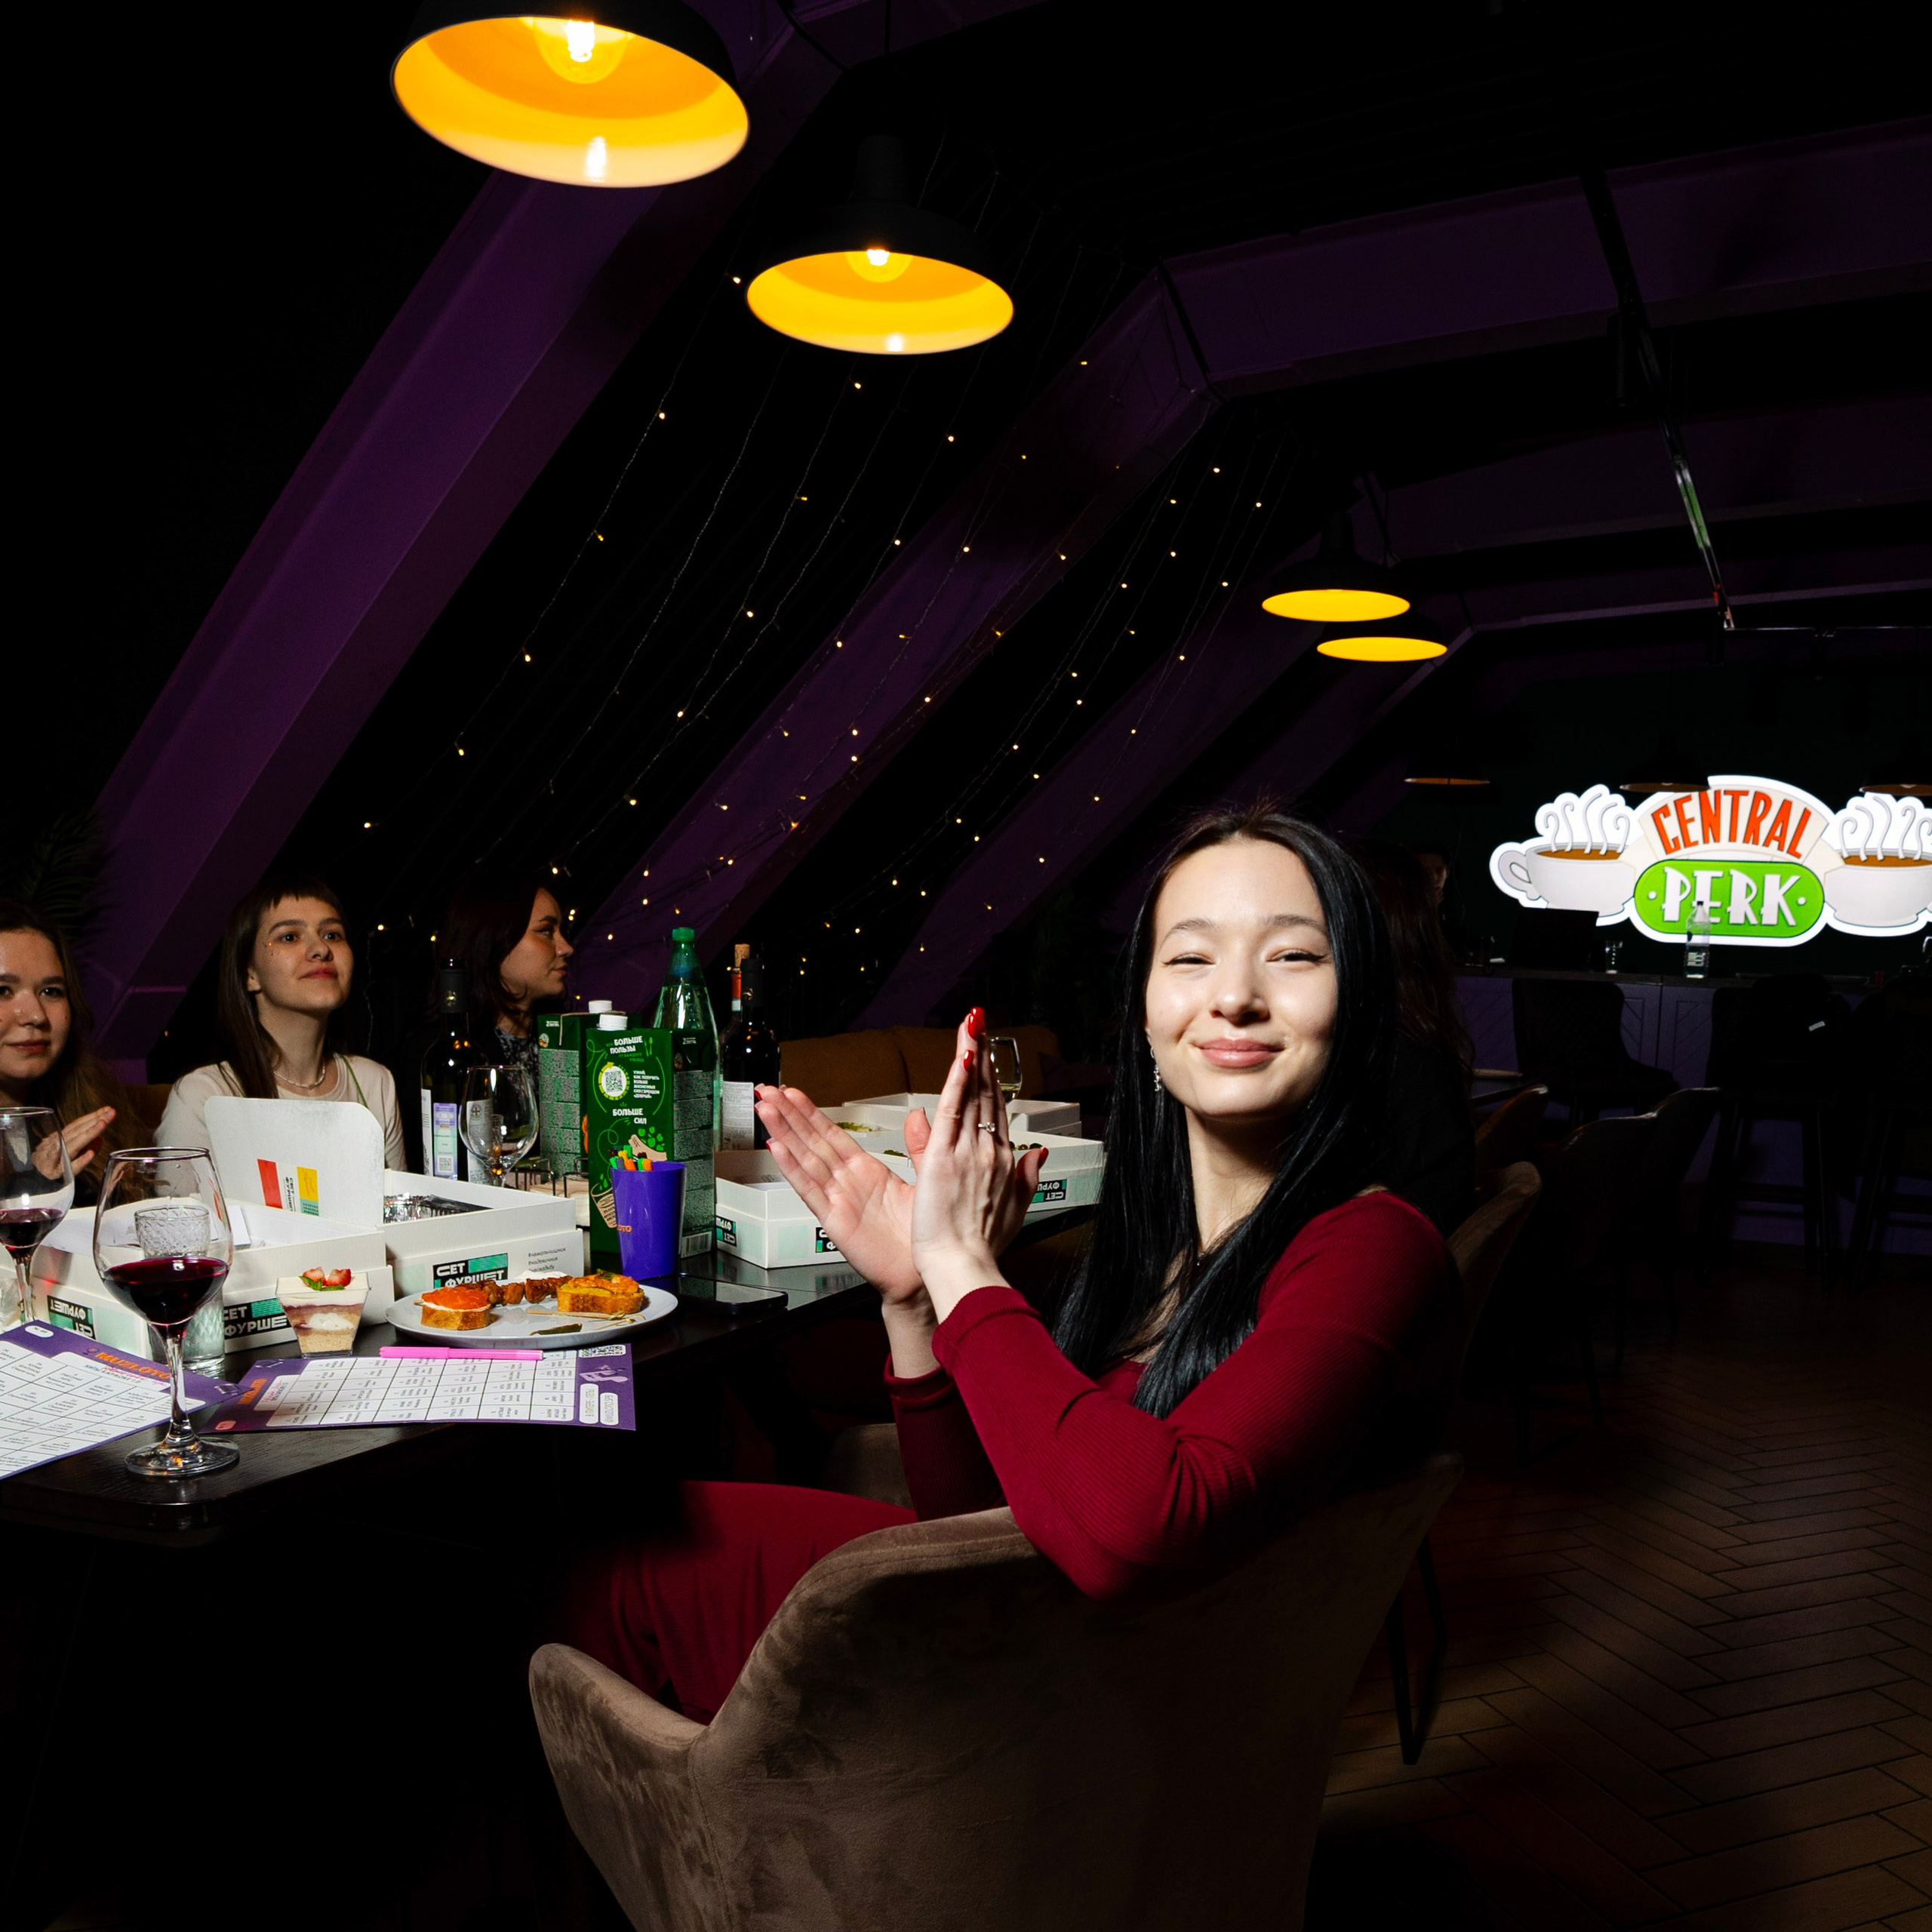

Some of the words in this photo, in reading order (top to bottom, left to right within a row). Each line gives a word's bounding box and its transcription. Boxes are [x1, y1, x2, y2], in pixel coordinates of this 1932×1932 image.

[1651, 789, 1813, 860] CENTRAL
[1662, 866, 1802, 927] PERK
[614, 1035, 644, 1046] БОЛЬШЕ
[609, 1044, 636, 1054] ПОЛЬЗЫ
[612, 1108, 644, 1116] БОЛЬШЕ
[1037, 1182, 1060, 1191] ФУРШ
[1045, 1192, 1064, 1200] СЕТ
[436, 1263, 466, 1277] СЕТ
[50, 1299, 86, 1321] ФУРШЕТ
[75, 1322, 94, 1337] СЕТ
[224, 1315, 288, 1337] ФУРШЕ
